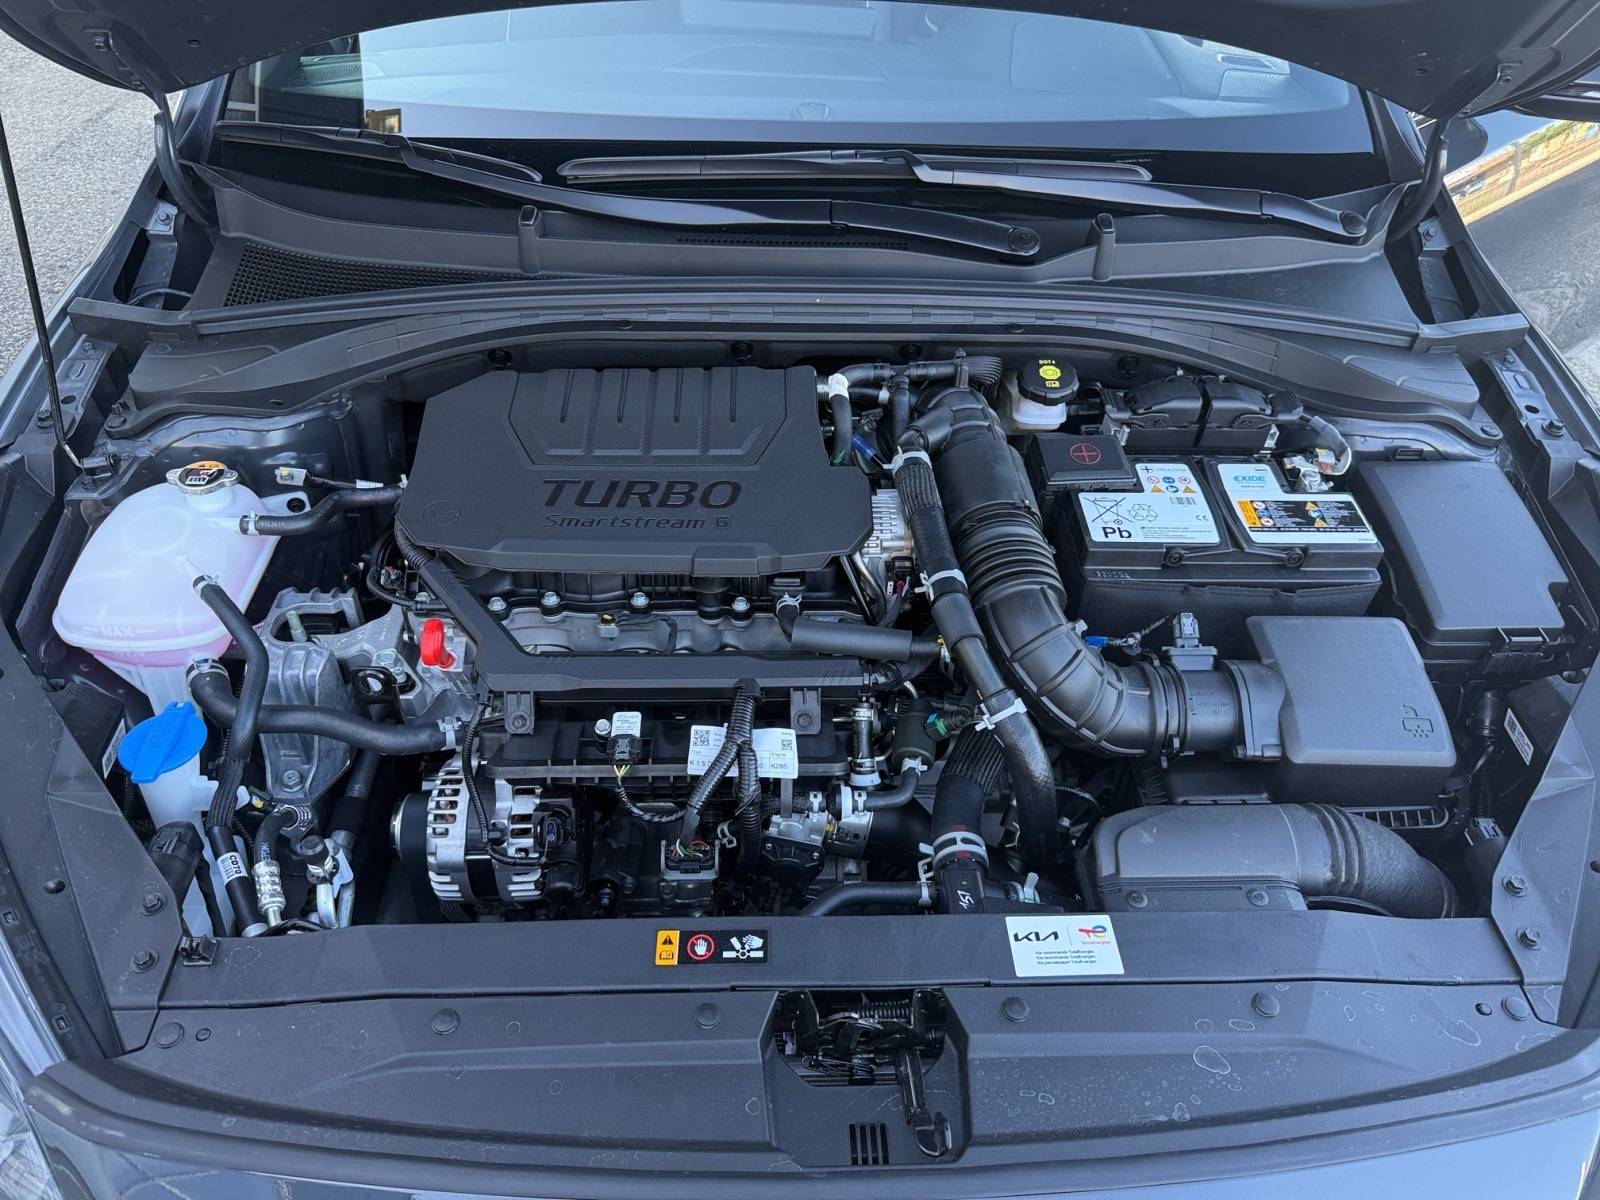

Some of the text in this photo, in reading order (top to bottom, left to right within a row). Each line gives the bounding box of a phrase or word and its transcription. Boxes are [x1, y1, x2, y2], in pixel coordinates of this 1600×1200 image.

[543, 479, 742, 509] TURBO
[543, 514, 705, 529] Smartstream
[1102, 526, 1133, 539] Pb
[99, 625, 135, 638] MAX
[1013, 930, 1060, 942] KIA
